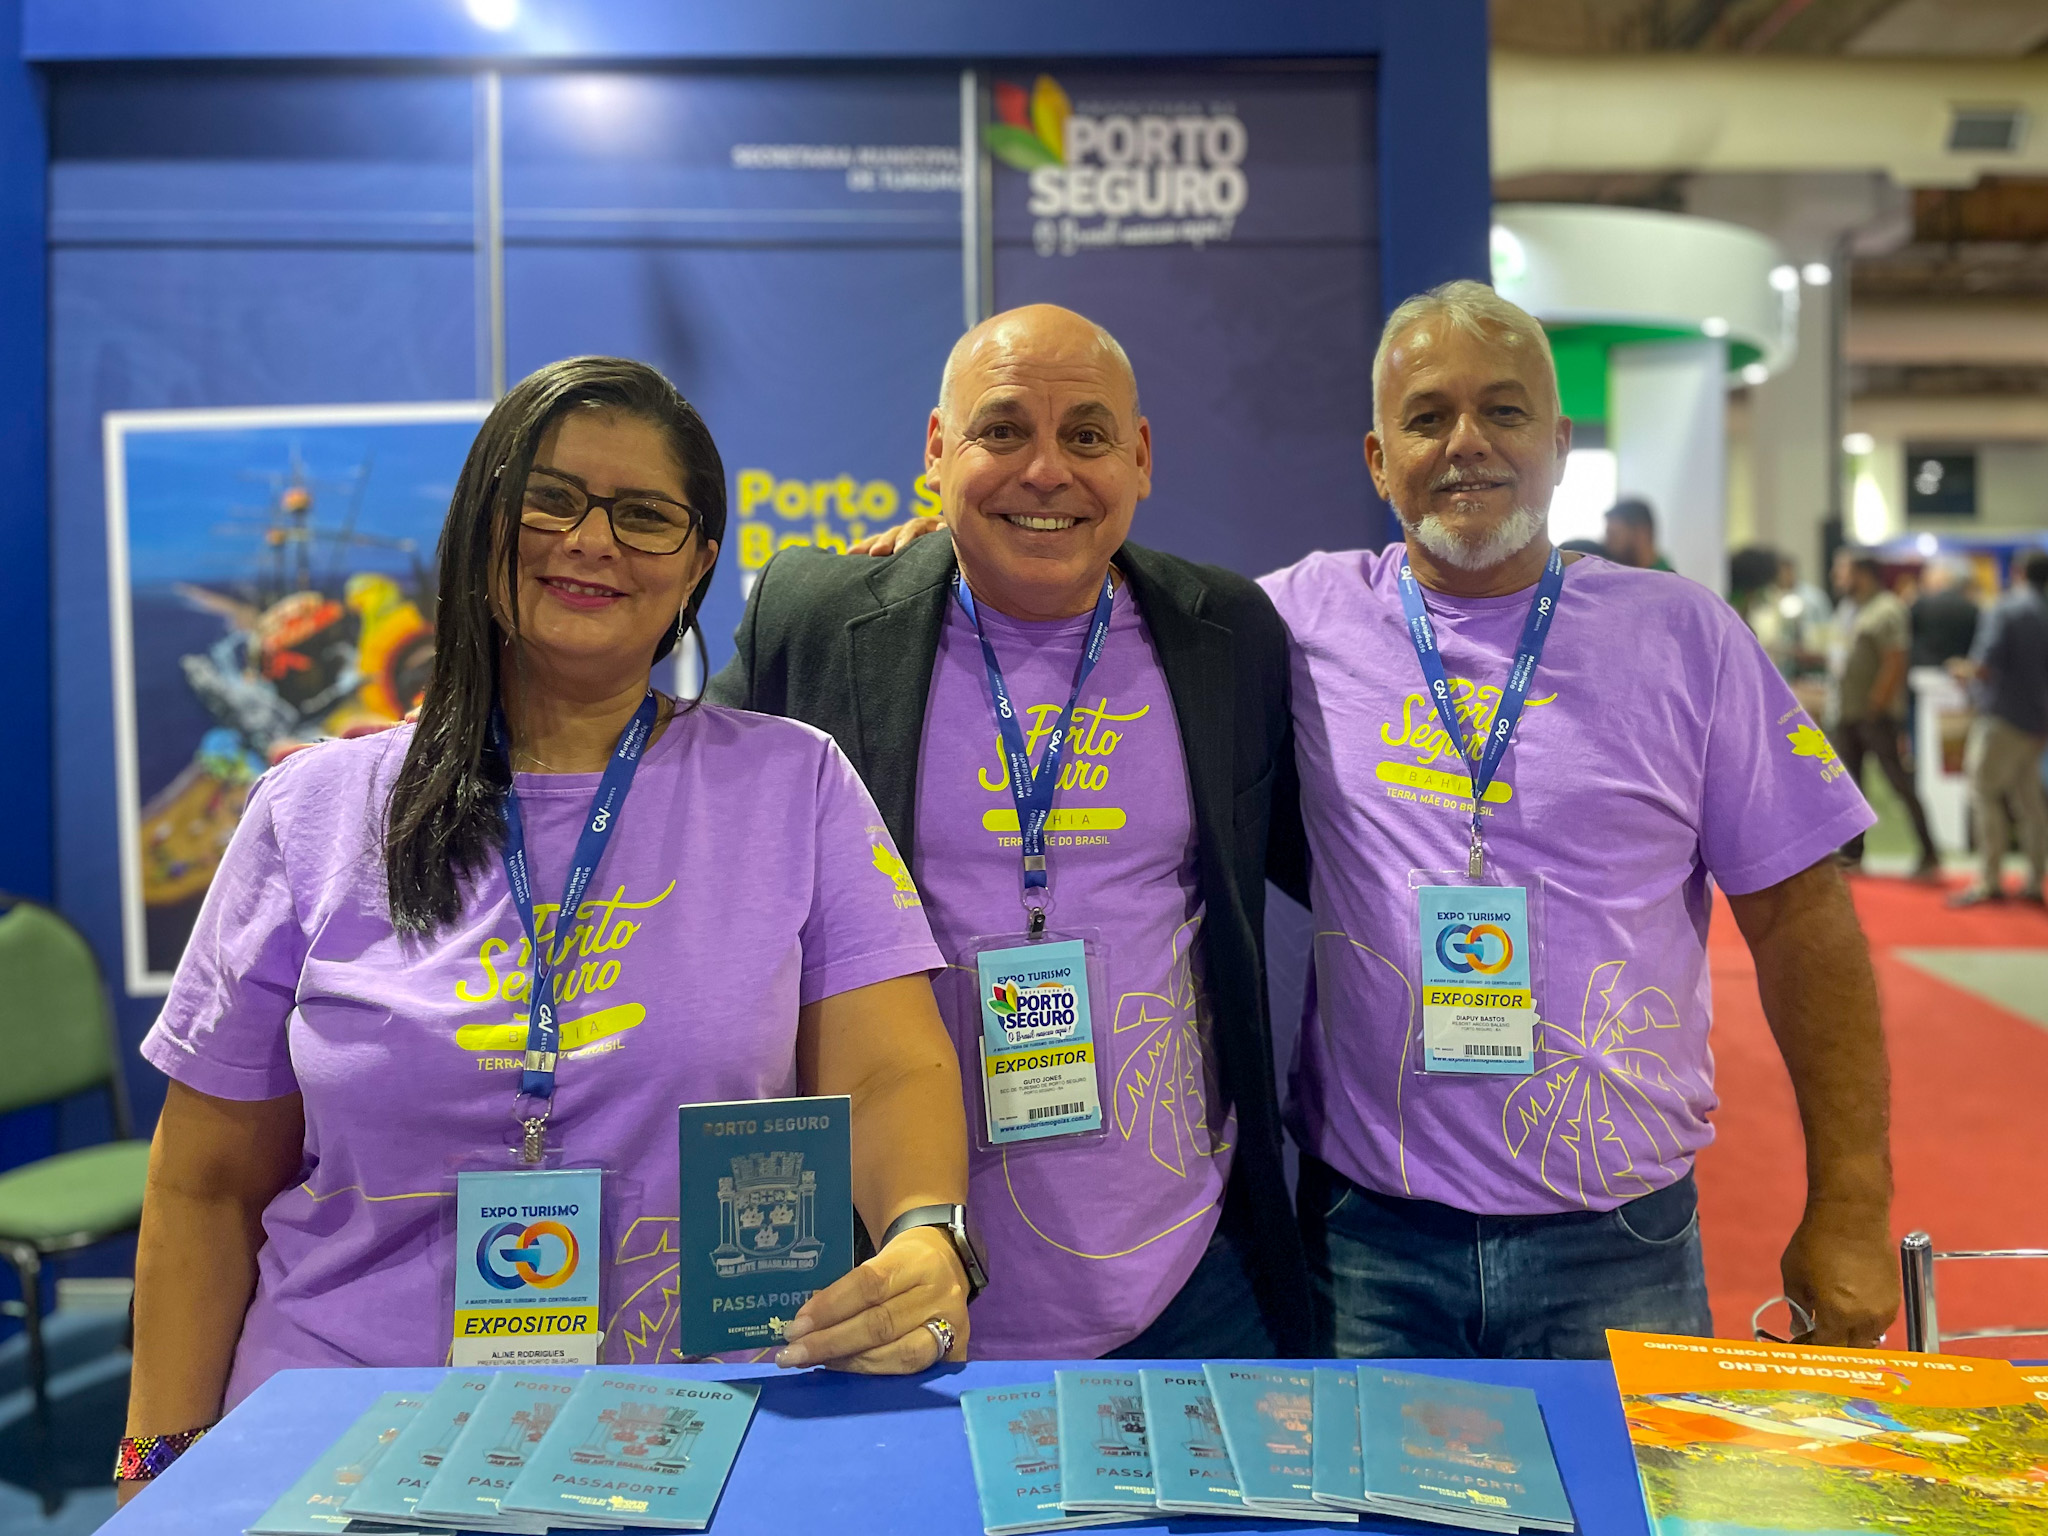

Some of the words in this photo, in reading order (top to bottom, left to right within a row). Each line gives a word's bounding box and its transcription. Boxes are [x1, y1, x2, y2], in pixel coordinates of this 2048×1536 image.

[1062, 115, 1247, 166] PORTO
[1027, 165, 1247, 217] SEGURO
[737, 469, 899, 519] Porto
[1026, 697, 1149, 756] Prto
[619, 719, 641, 758] Multiplique
[627, 726, 649, 761] felicidade
[1011, 753, 1024, 798] Multiplique
[1386, 787, 1417, 801] TERRA
[1419, 792, 1441, 806] MÃE
[1443, 799, 1457, 809] DO
[998, 837, 1023, 847] TERR
[1058, 836, 1073, 846] DO
[1076, 835, 1110, 845] BRASIL
[509, 855, 526, 905] felicidade
[1437, 912, 1464, 921] EXPO
[1467, 912, 1511, 922] TURISMO
[455, 938, 622, 1021] Seuro
[1028, 968, 1071, 981] TURISMO
[1017, 993, 1074, 1012] PORTO
[1431, 992, 1523, 1007] EXPOSITOR
[1006, 1010, 1075, 1029] SEGURO
[476, 1057, 523, 1071] TERRA
[995, 1050, 1087, 1074] EXPOSITOR
[703, 1120, 757, 1136] PORTO
[763, 1115, 830, 1132] SEGURO
[481, 1207, 517, 1218] EXPO
[521, 1204, 579, 1218] TURISMO
[464, 1315, 588, 1335] EXPOSITOR
[517, 1350, 565, 1358] RODRIGUES
[1712, 1347, 1768, 1358] PORTO
[1771, 1351, 1797, 1359] EM
[1801, 1353, 1886, 1366] INCLUSIVE
[1718, 1360, 1883, 1380] ARCOBALENO
[1889, 1359, 1918, 1368] ALL
[1923, 1361, 1956, 1371] SEU
[514, 1381, 571, 1394] PORTO
[602, 1380, 658, 1394] PORTO
[665, 1388, 733, 1401] SEGURO
[1080, 1378, 1133, 1387] PORTO
[986, 1391, 1040, 1402] PORTO
[552, 1473, 679, 1496] PASSAPORTE
